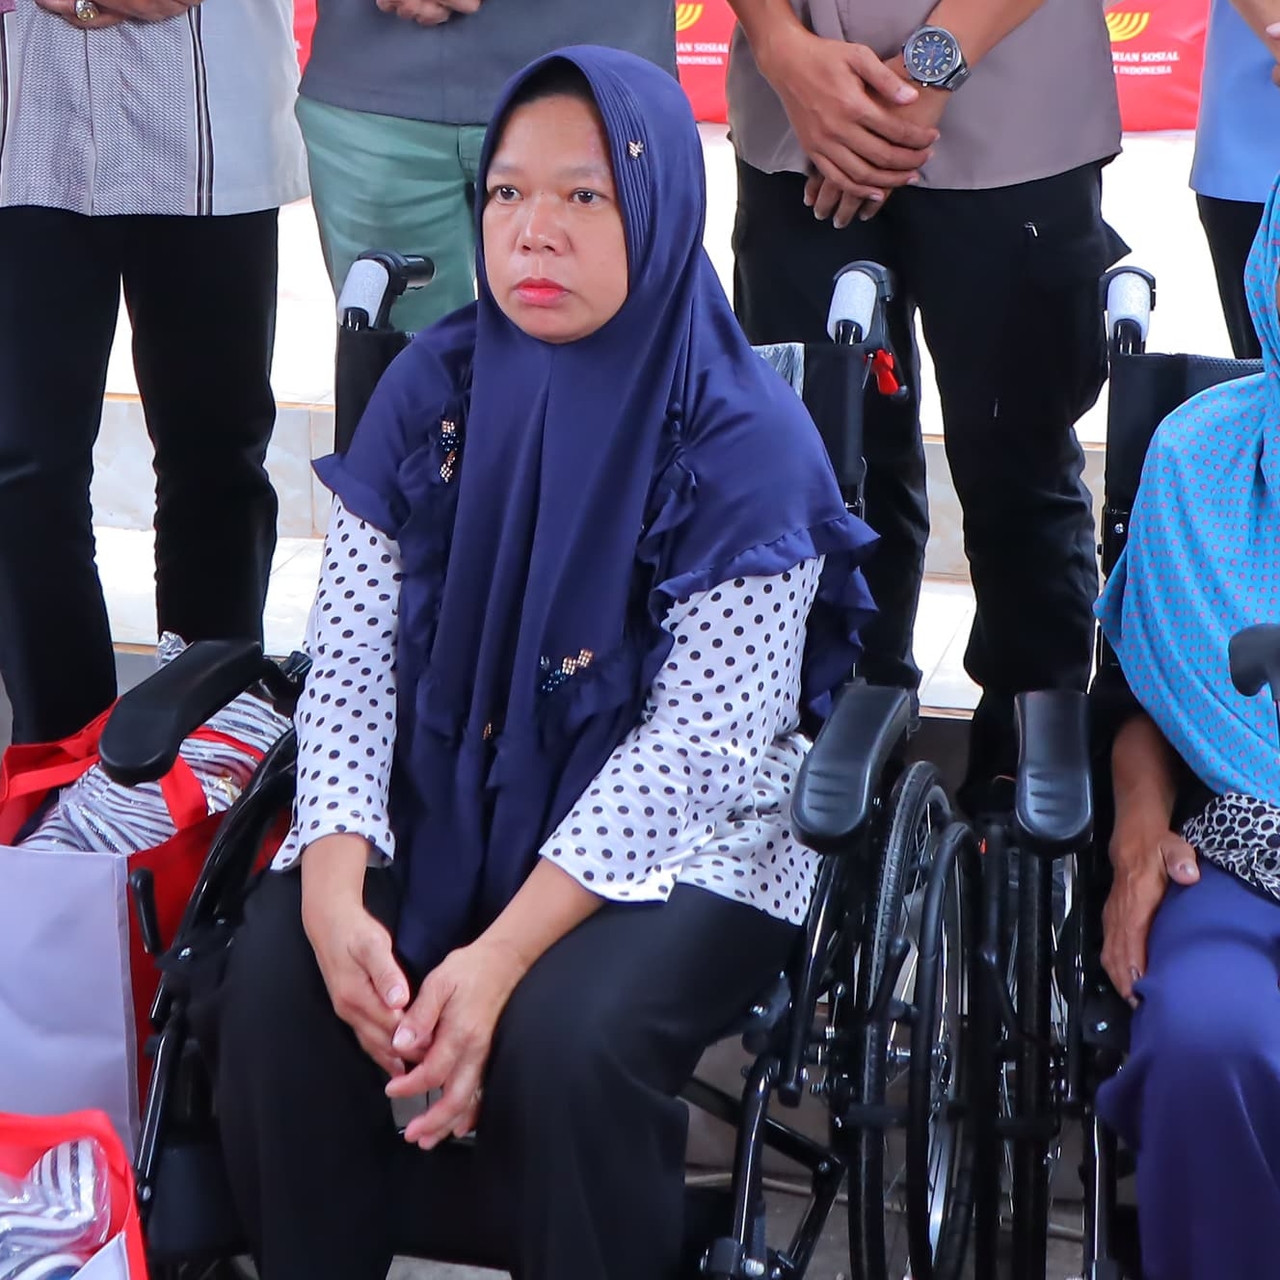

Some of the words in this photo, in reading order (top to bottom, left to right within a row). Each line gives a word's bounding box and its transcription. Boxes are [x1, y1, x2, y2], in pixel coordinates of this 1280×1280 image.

[693, 42, 729, 53] SOSIAL
[1140, 50, 1180, 62] SOSIAL
[1119, 64, 1173, 75] INDONESIA
